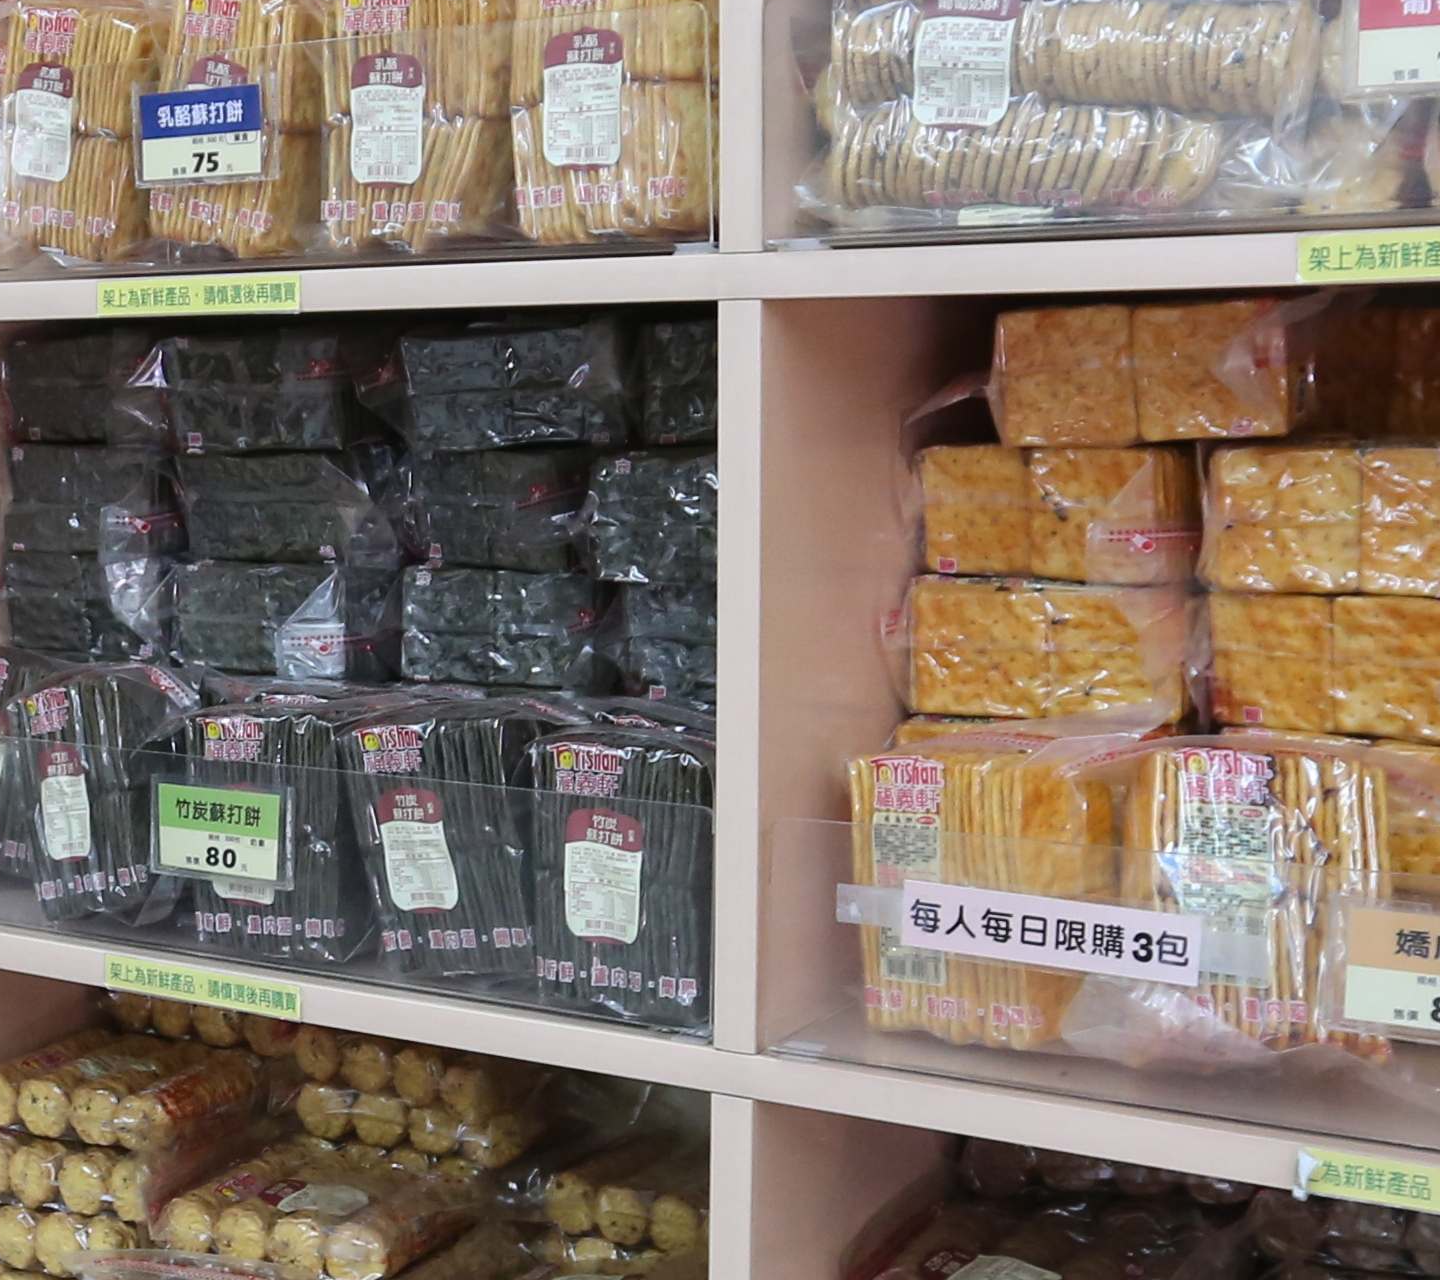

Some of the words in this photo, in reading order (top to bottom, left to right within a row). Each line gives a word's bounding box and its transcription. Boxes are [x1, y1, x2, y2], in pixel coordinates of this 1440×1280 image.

[342, 7, 407, 33] 福義軒
[157, 98, 244, 129] 乳酪蘇打餅
[191, 151, 220, 174] 75
[555, 771, 619, 799] 福義軒
[873, 785, 941, 812] 福義軒
[175, 797, 262, 828] 竹炭蘇打餅
[204, 846, 238, 870] 80
[910, 898, 1190, 968] 每人每日限購3包
